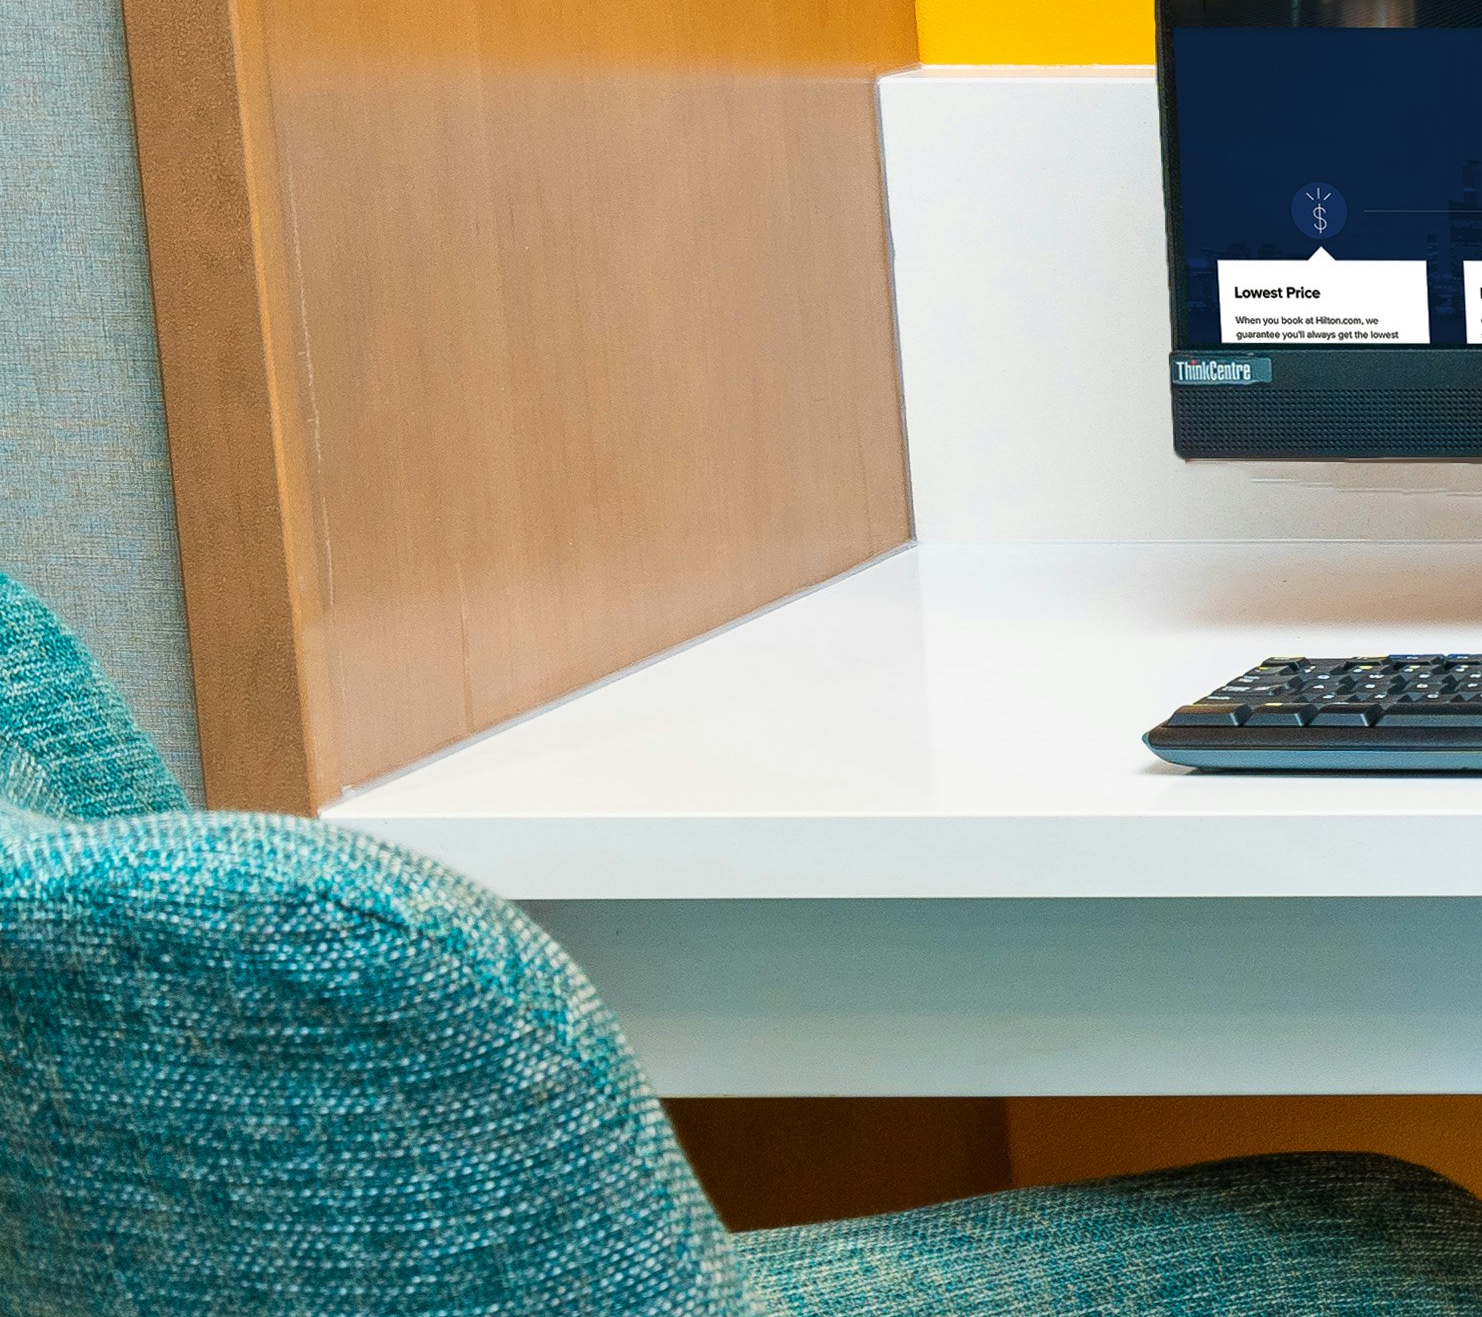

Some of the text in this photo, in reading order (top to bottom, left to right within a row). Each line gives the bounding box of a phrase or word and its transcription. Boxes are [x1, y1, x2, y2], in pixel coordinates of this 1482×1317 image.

[1234, 286, 1321, 300] Lowest Price
[1234, 315, 1262, 325] When
[1262, 317, 1280, 327] you
[1280, 315, 1304, 325] book
[1304, 316, 1315, 325] at
[1365, 317, 1379, 326] we
[1235, 330, 1400, 341] guarantee you'll always get the lowest
[1175, 361, 1251, 380] ThinkCentre
